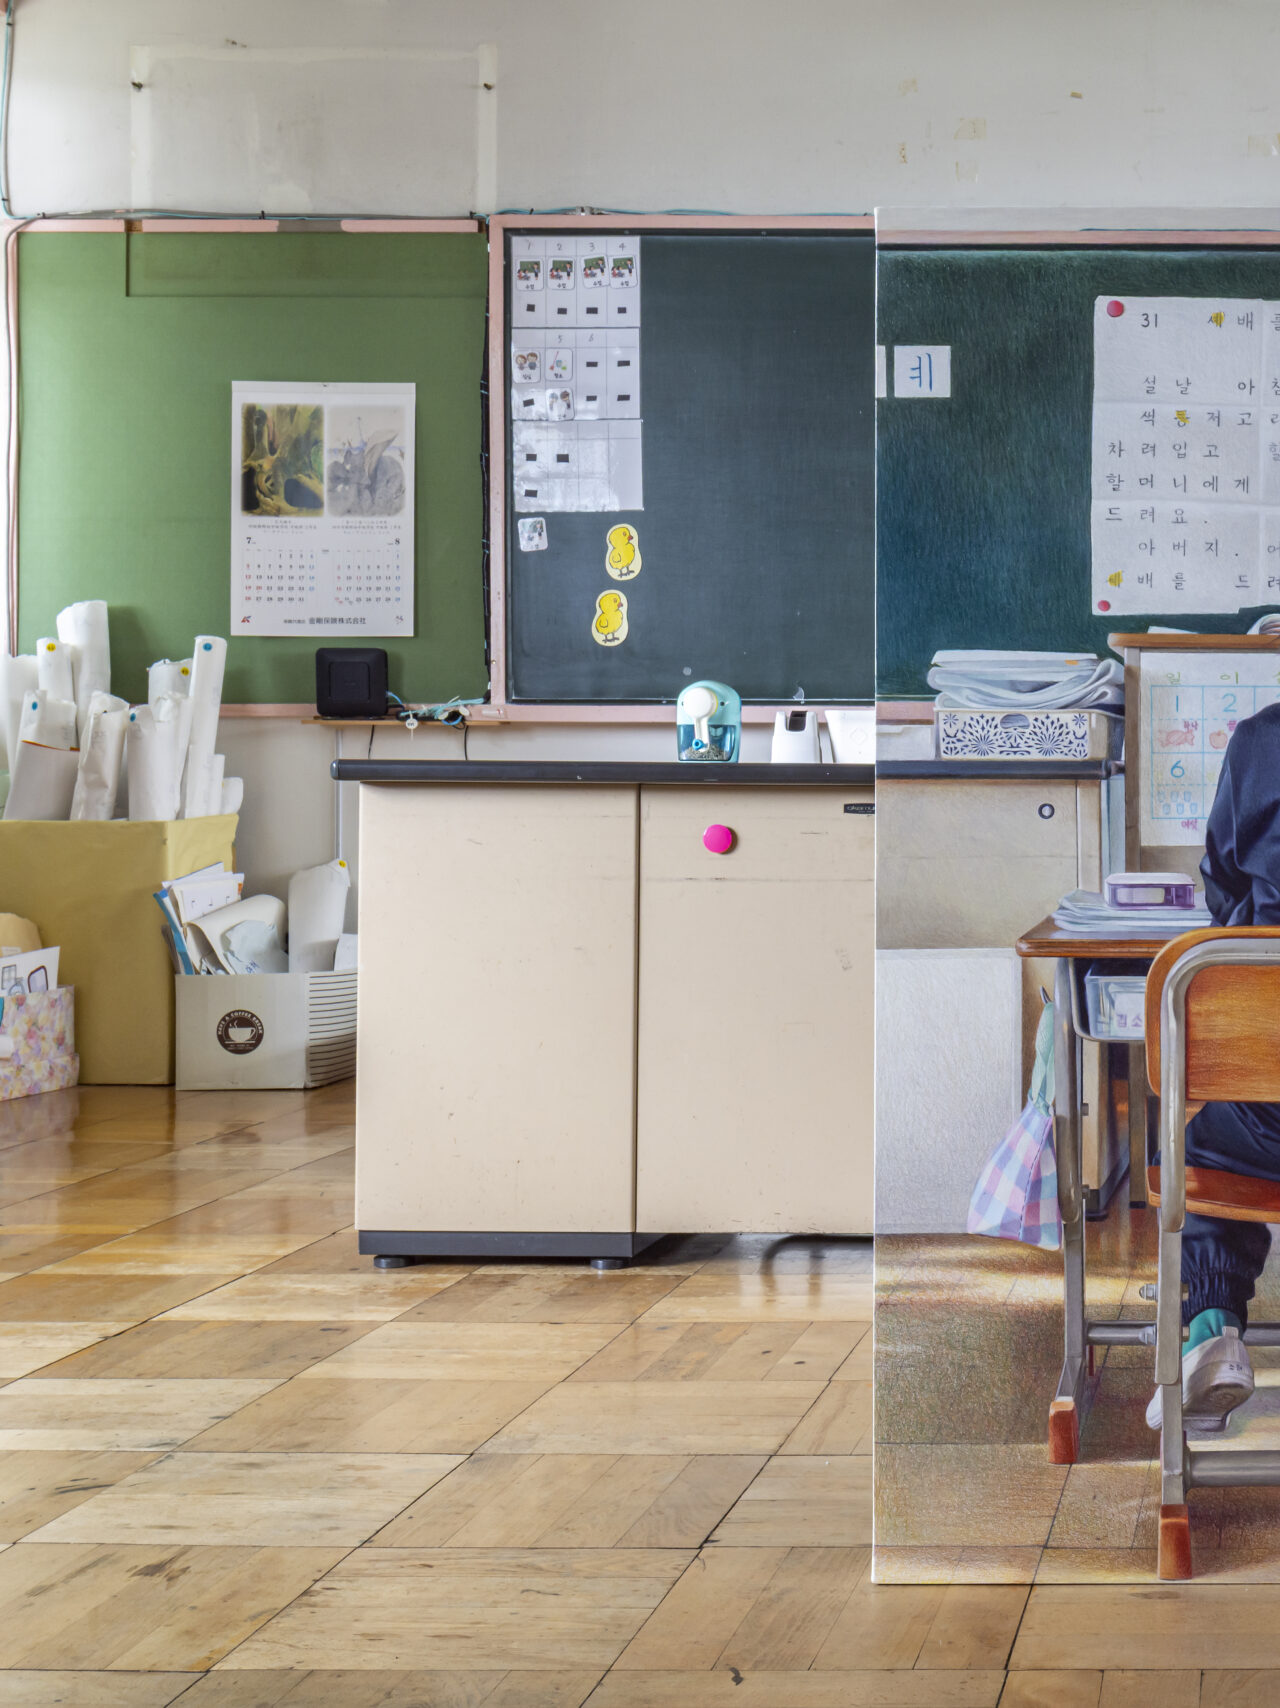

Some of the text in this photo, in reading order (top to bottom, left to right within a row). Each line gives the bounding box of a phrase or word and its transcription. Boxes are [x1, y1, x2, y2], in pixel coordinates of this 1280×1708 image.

[1141, 313, 1158, 328] 31
[1143, 376, 1192, 395] 설날
[1108, 440, 1220, 459] 차려입고
[1106, 473, 1249, 494] 할머니에게
[1221, 693, 1237, 713] 2
[1170, 760, 1185, 778] 6
